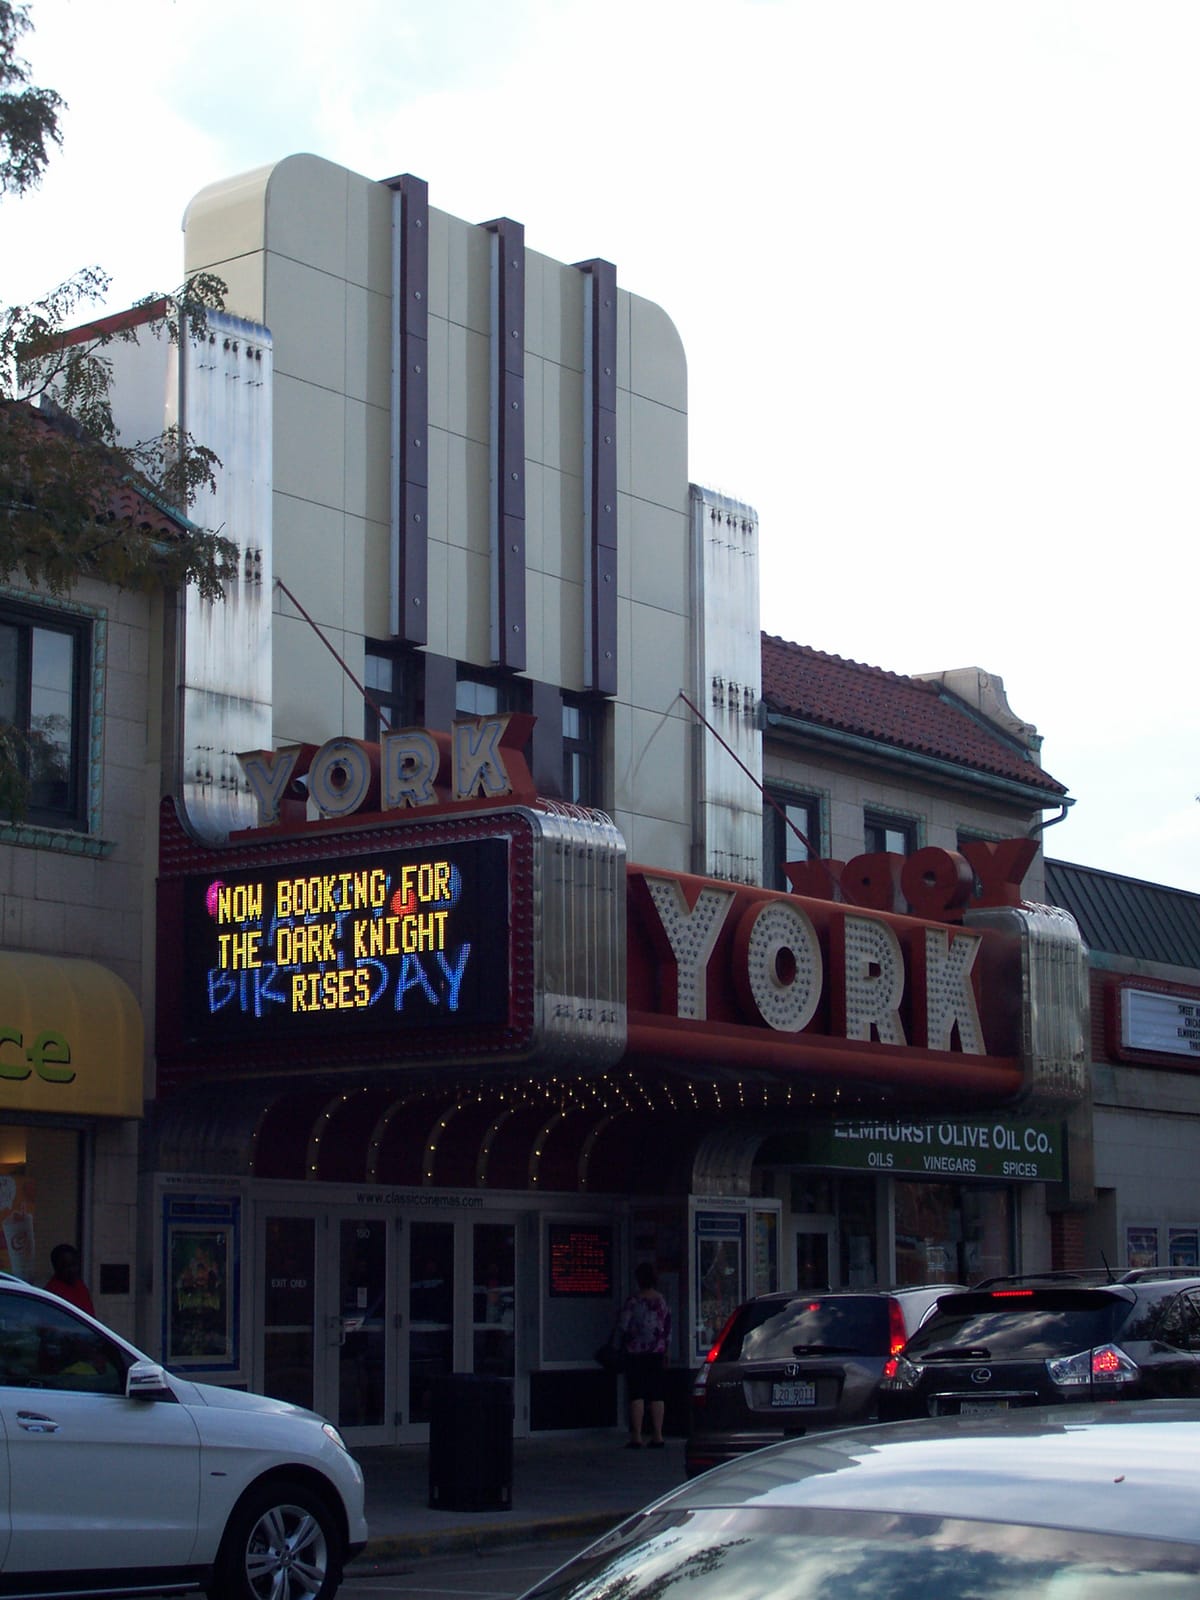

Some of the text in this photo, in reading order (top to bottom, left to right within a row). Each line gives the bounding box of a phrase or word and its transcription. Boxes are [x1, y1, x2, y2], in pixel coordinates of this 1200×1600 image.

[237, 713, 512, 828] YORK
[218, 883, 262, 924] NOW
[277, 869, 386, 918] BOOKING
[402, 862, 451, 904] FOR
[218, 911, 449, 970] THE DARK KNIGHT
[643, 873, 988, 1056] YORK
[292, 968, 370, 1012] RISES
[834, 1121, 934, 1144] ELMHURST
[939, 1122, 989, 1149] OLIVE
[992, 1125, 1021, 1151] OIL
[868, 1152, 1038, 1177] OILS VINEGARS SPICES
[356, 1191, 483, 1208] www.classiccinemas.com
[271, 1278, 288, 1289] EXIT
